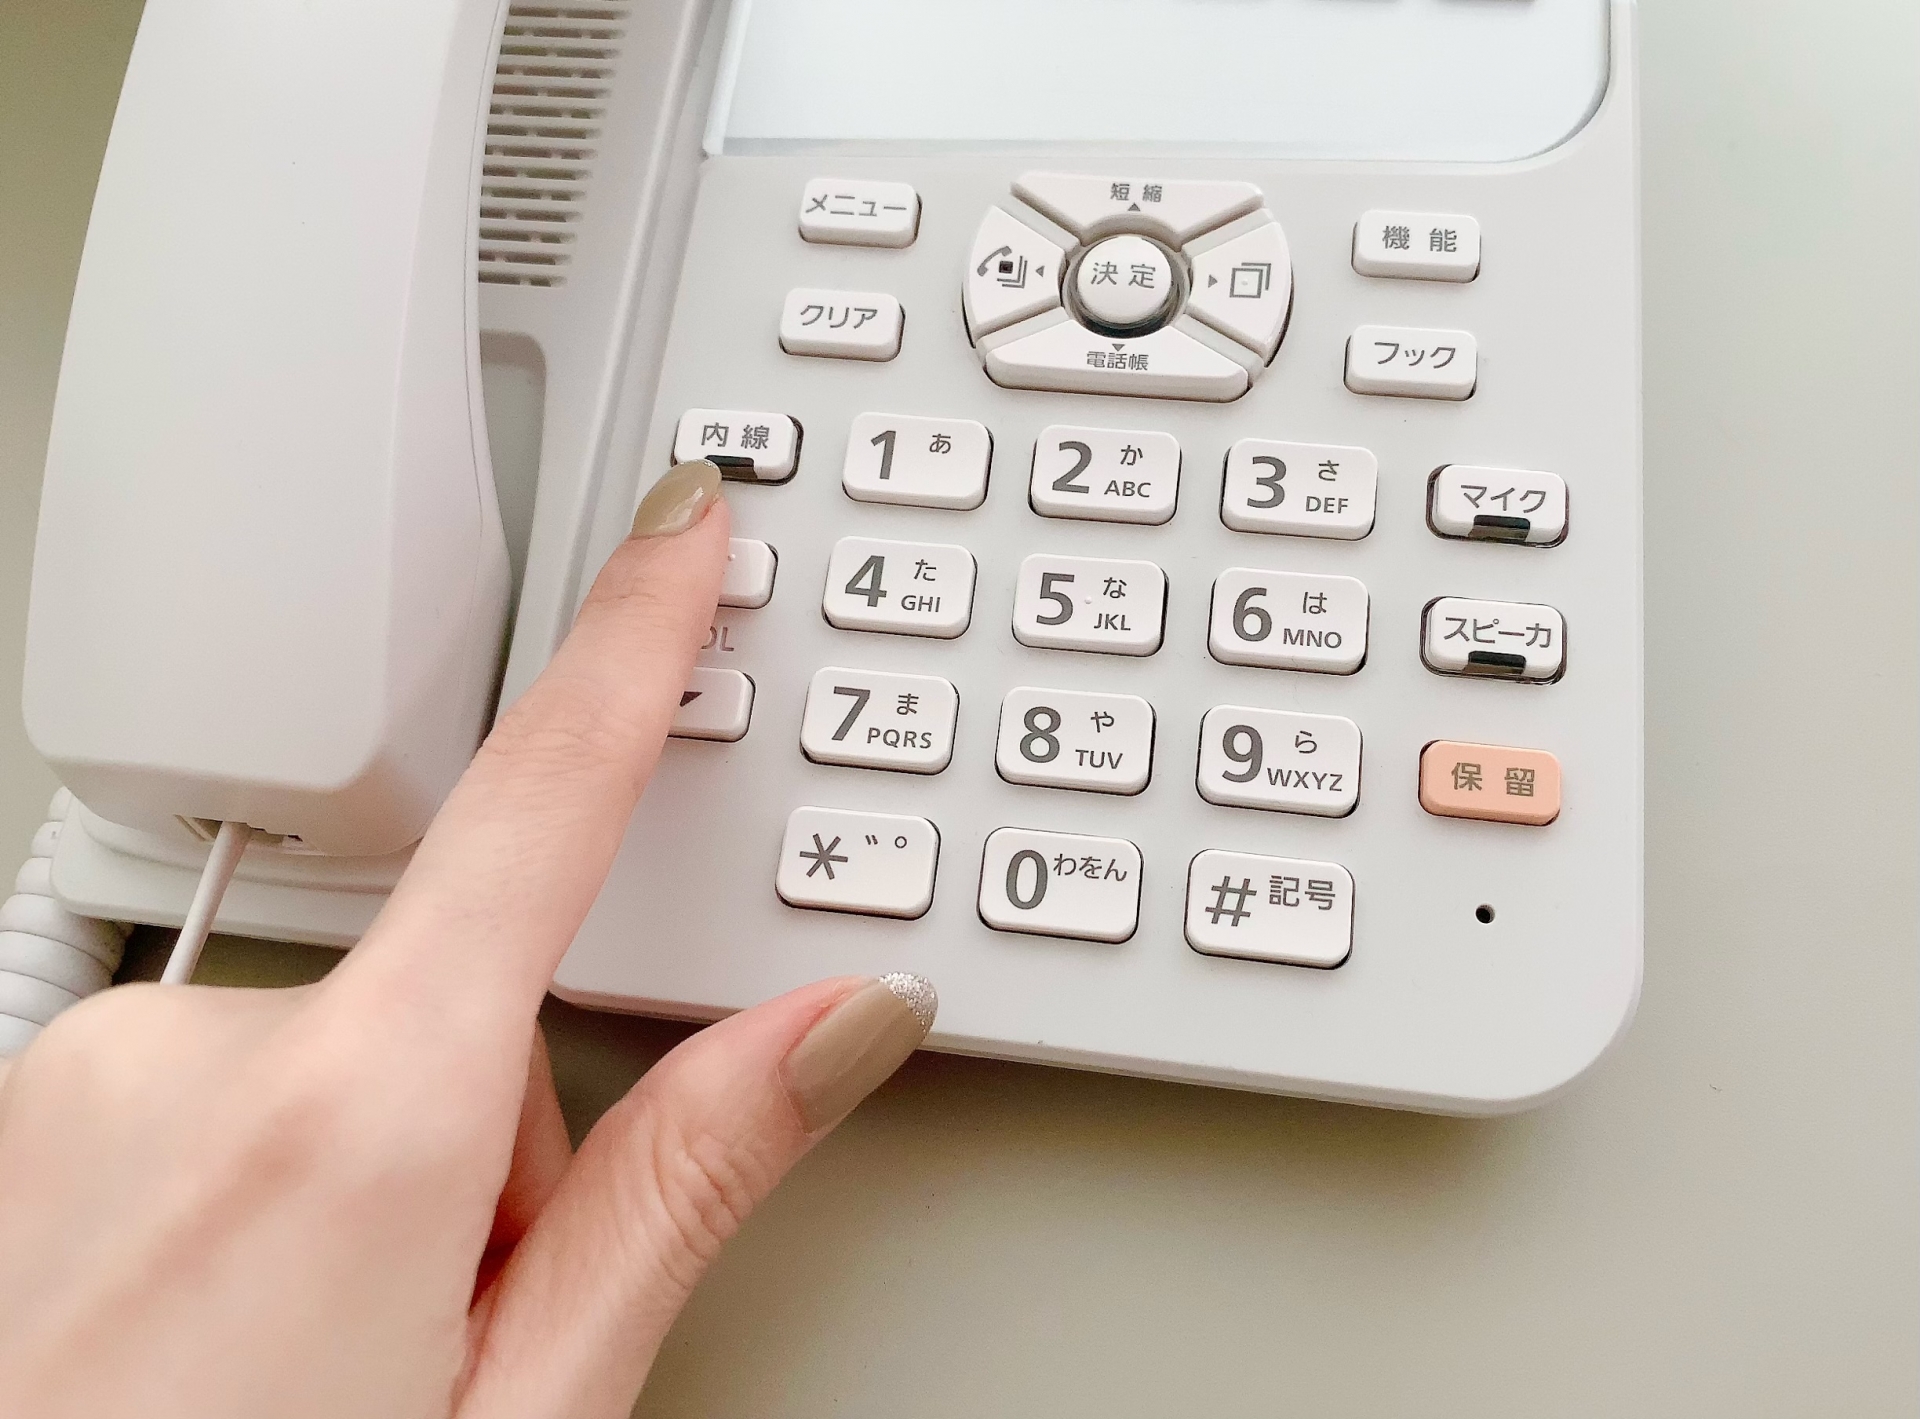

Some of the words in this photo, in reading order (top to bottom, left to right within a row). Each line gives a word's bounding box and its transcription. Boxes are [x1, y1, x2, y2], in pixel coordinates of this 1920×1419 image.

[806, 194, 907, 216] メニュー
[800, 305, 877, 329] クリア
[1087, 351, 1148, 373] 電話帳
[1375, 342, 1455, 369] フック
[871, 430, 896, 479] 1
[929, 434, 951, 454] あ
[1120, 445, 1143, 466] か
[1052, 441, 1092, 494] 2
[1319, 460, 1339, 481] さ
[1104, 480, 1151, 497] ABC
[1247, 456, 1286, 508] 3
[1306, 496, 1348, 513] DEF
[1461, 485, 1546, 513] マイク
[845, 555, 887, 607] 4
[914, 559, 936, 581] た
[1036, 572, 1074, 625] 5
[1103, 577, 1127, 598] な
[901, 595, 940, 612] GHI
[1303, 592, 1327, 614] は
[1094, 613, 1131, 631] JKL
[1233, 587, 1272, 642] 6
[1283, 628, 1341, 648] MNO
[1444, 617, 1551, 648] スピーカ
[832, 686, 871, 741] 7
[897, 693, 919, 715] ま
[1091, 711, 1114, 733] や
[867, 728, 931, 749] PQRS
[1020, 706, 1061, 763] 8
[1295, 731, 1317, 753] ら
[1075, 749, 1123, 769] TUV
[1222, 725, 1263, 783] 9
[1267, 768, 1342, 791] WXYZ
[1053, 854, 1127, 881] わをん
[1006, 850, 1048, 910] 0
[1205, 876, 1257, 927] #
[1269, 875, 1335, 910] 記号
